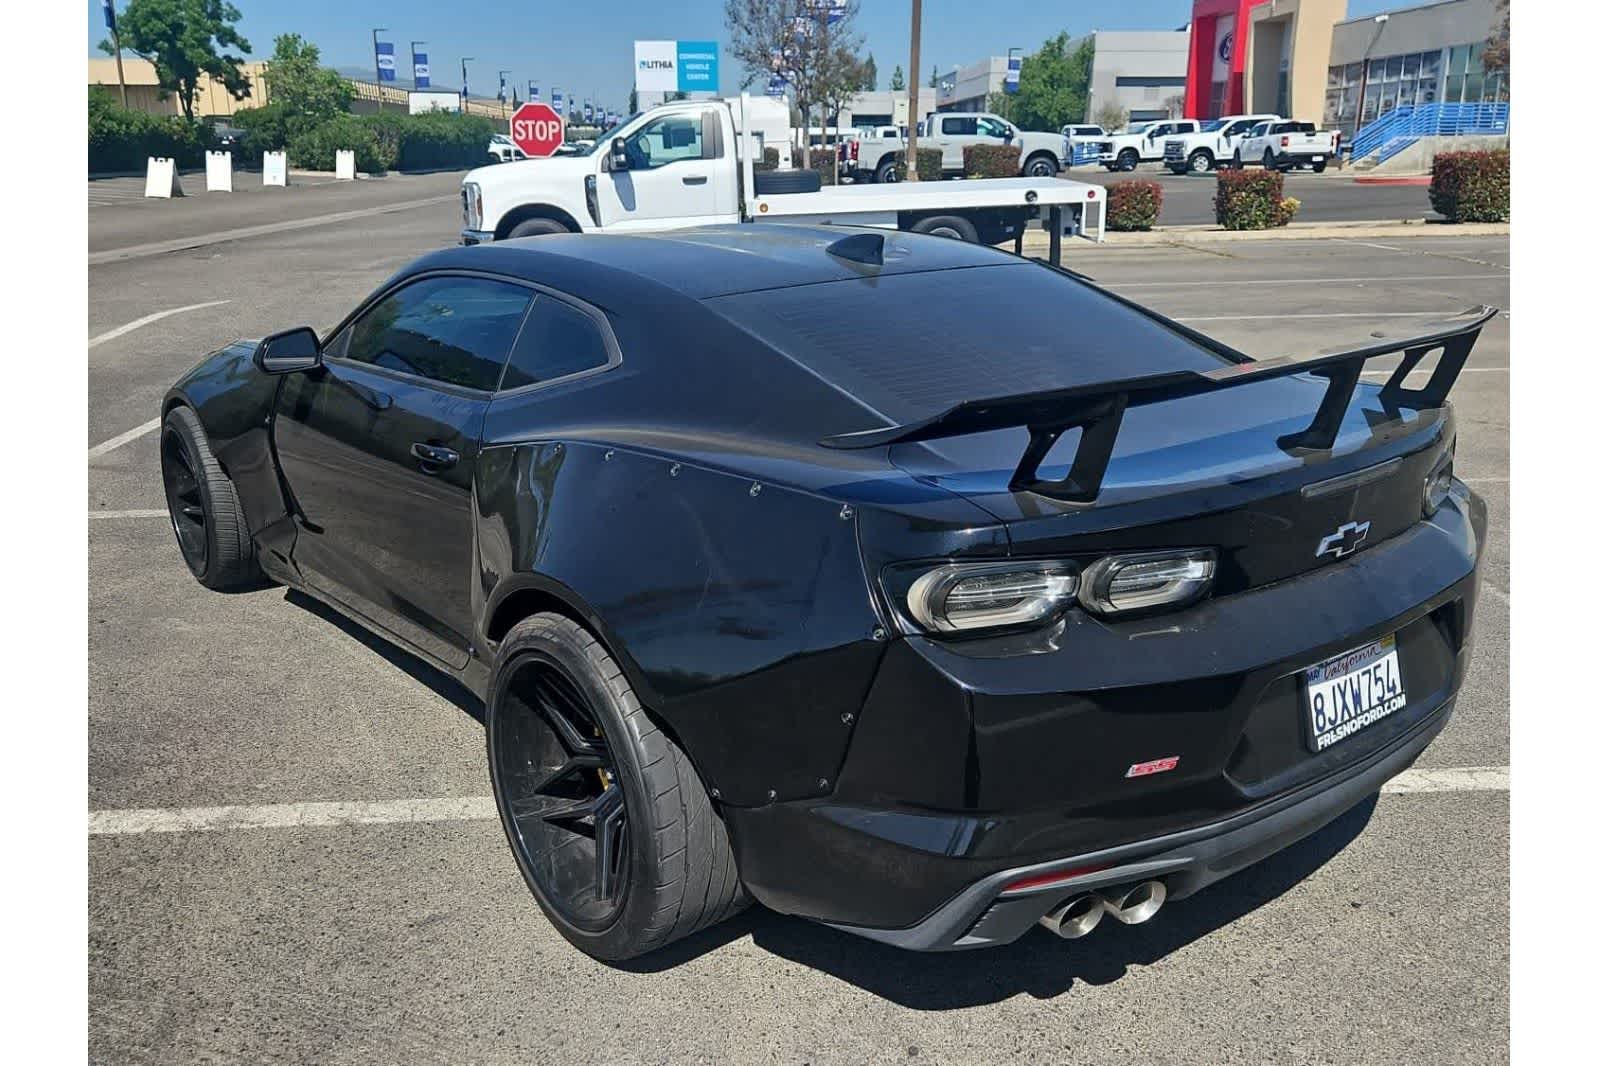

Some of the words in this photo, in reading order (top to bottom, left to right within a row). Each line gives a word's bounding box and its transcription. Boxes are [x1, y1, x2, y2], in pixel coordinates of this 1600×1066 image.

[647, 60, 673, 69] LITHIA
[514, 120, 561, 142] STOP
[1314, 659, 1397, 732] 8JXW754
[1317, 694, 1407, 751] FRESNOFORD.COM
